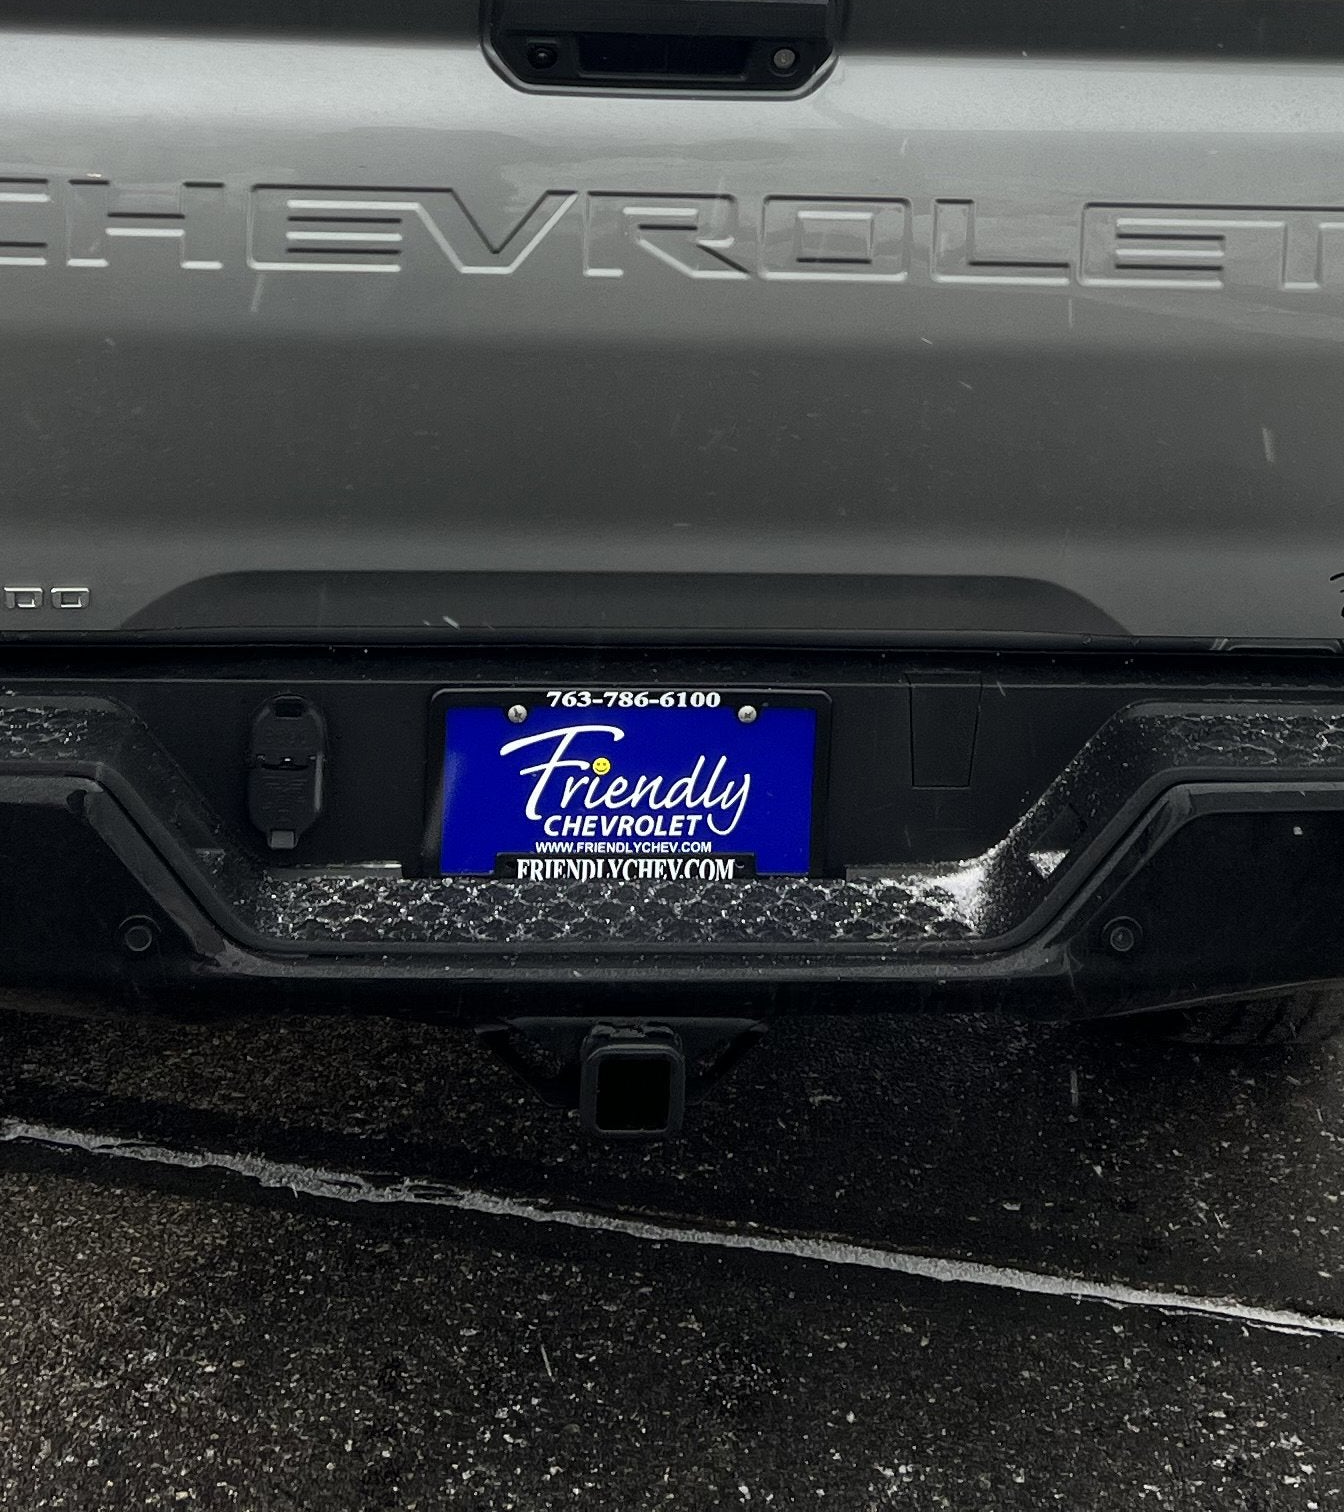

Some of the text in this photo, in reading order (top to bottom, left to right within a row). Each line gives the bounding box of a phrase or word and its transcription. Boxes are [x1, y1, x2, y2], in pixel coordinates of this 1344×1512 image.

[546, 691, 721, 707] 763-786-6100
[499, 724, 751, 835] Friendly
[543, 815, 702, 837] CHEVROLET
[535, 841, 712, 853] WWW.FRIENDLYCHEV.COM
[516, 859, 736, 882] FRIENDLYCHEV.COM
